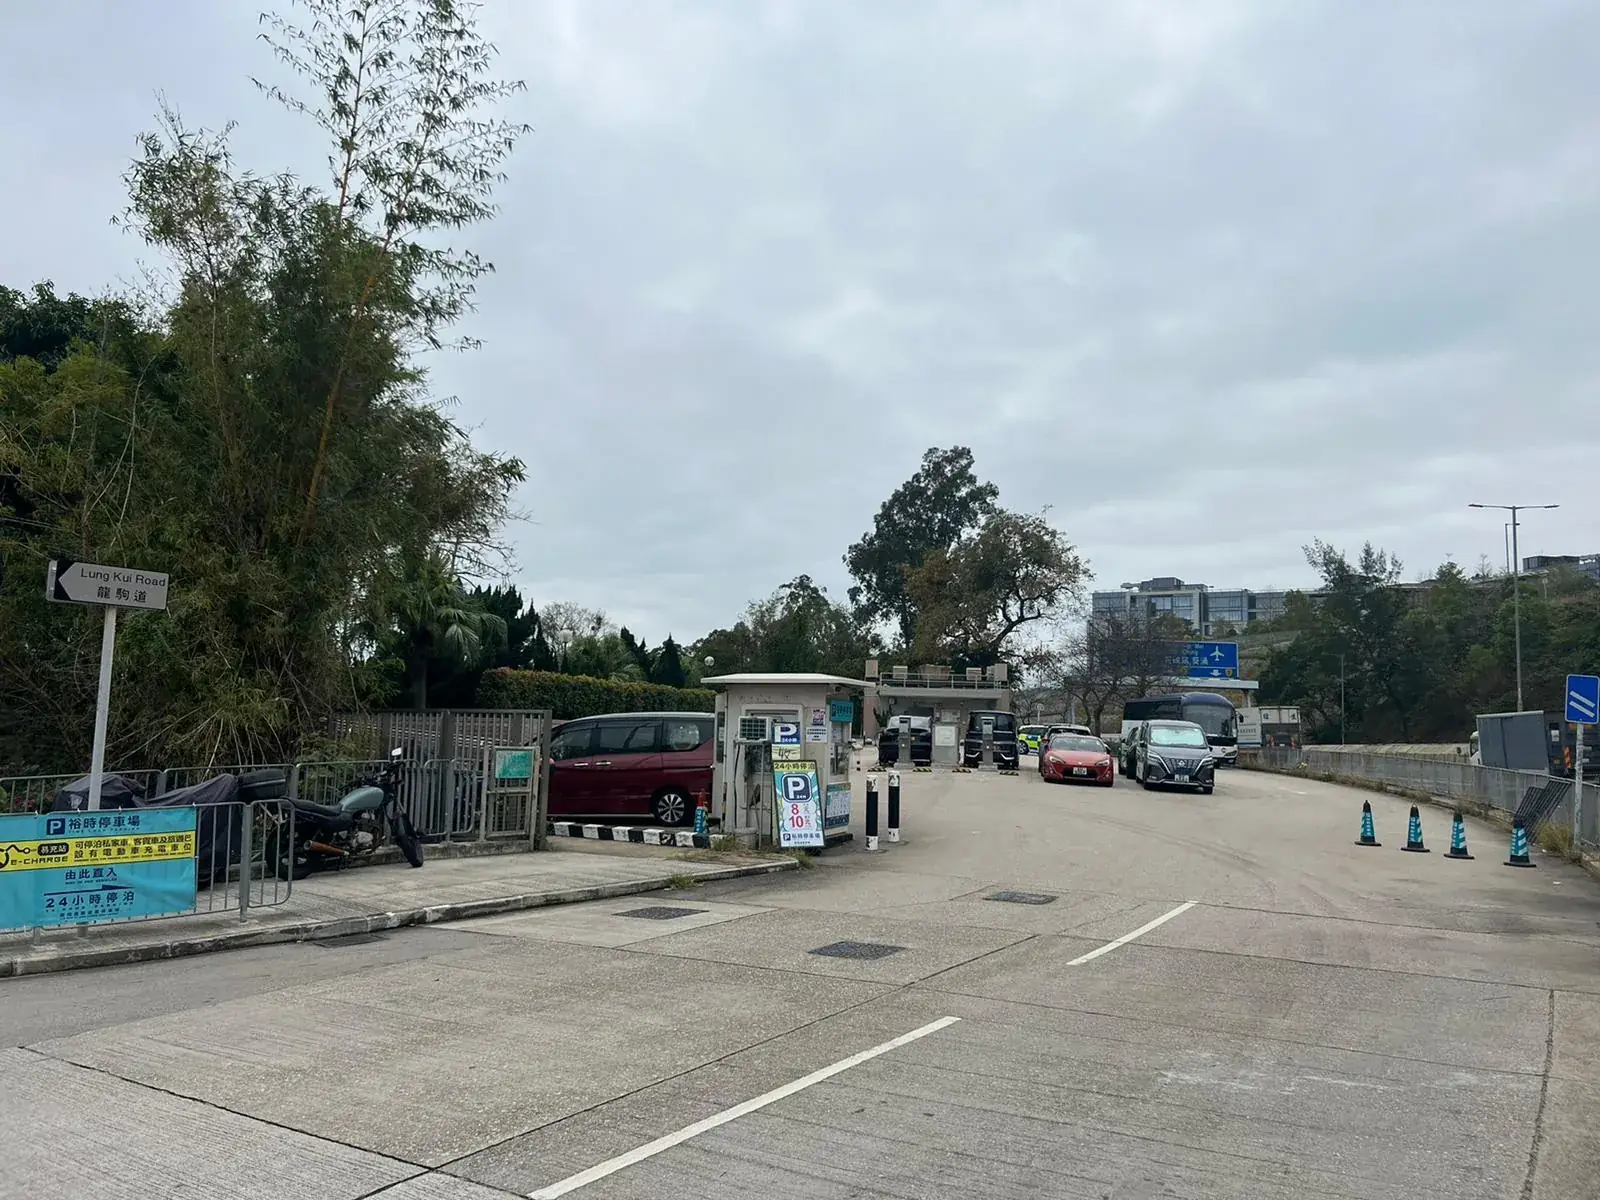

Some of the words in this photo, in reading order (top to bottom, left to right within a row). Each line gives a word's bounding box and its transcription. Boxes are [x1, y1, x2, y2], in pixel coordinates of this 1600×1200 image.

[80, 568, 110, 582] Lung
[113, 572, 132, 583] Kui
[135, 574, 166, 587] Road
[97, 586, 147, 603] 龍駒道
[774, 723, 797, 743] P
[787, 777, 805, 799] P
[791, 803, 799, 815] 8
[50, 821, 61, 834] P
[68, 815, 140, 830] 裕時停車場
[789, 815, 804, 828] 10
[65, 867, 117, 880] 由此直入
[46, 891, 135, 908] 24小時停泊
